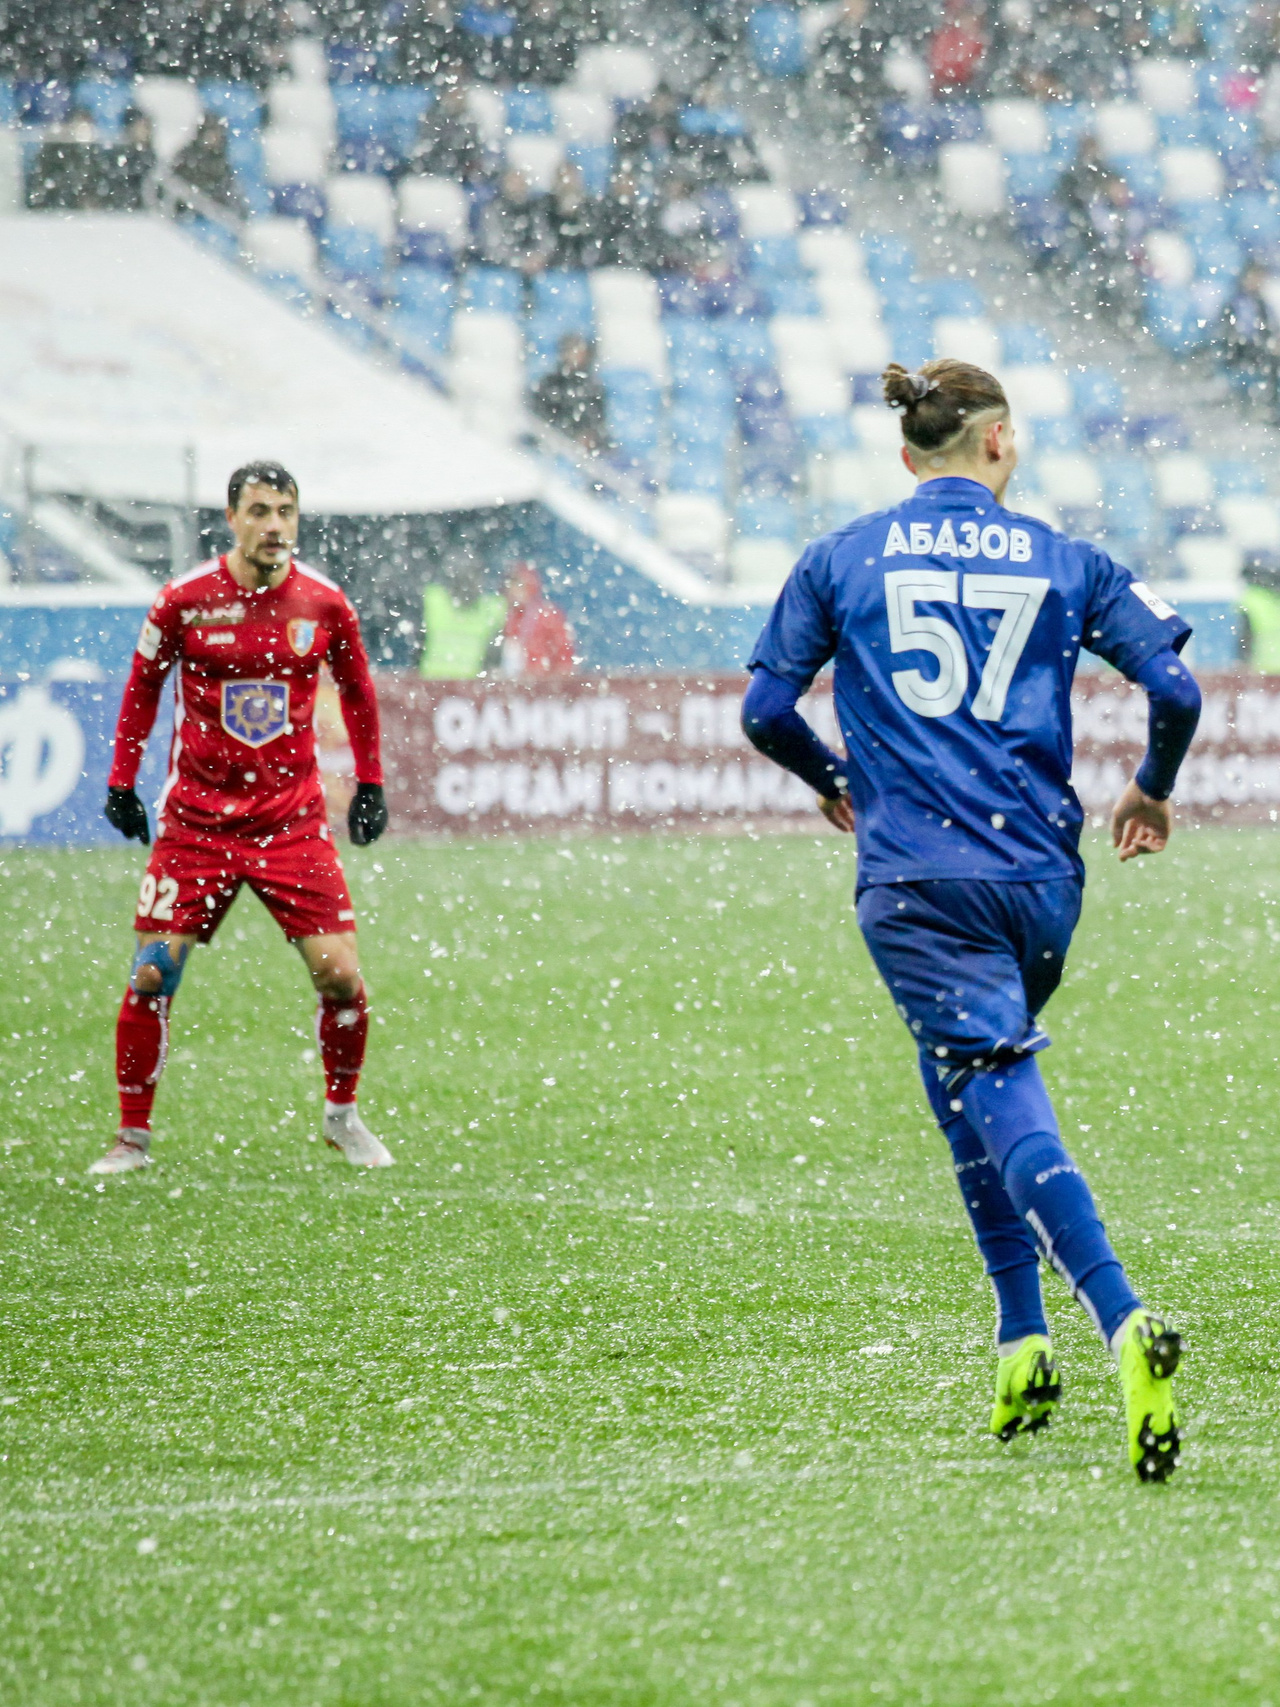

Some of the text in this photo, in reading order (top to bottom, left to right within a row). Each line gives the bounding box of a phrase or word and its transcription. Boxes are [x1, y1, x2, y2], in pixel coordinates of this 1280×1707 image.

[883, 521, 1032, 562] АБАЗОВ
[884, 570, 1051, 722] 57
[434, 761, 600, 816] СРЕДИ
[136, 873, 179, 921] 92
